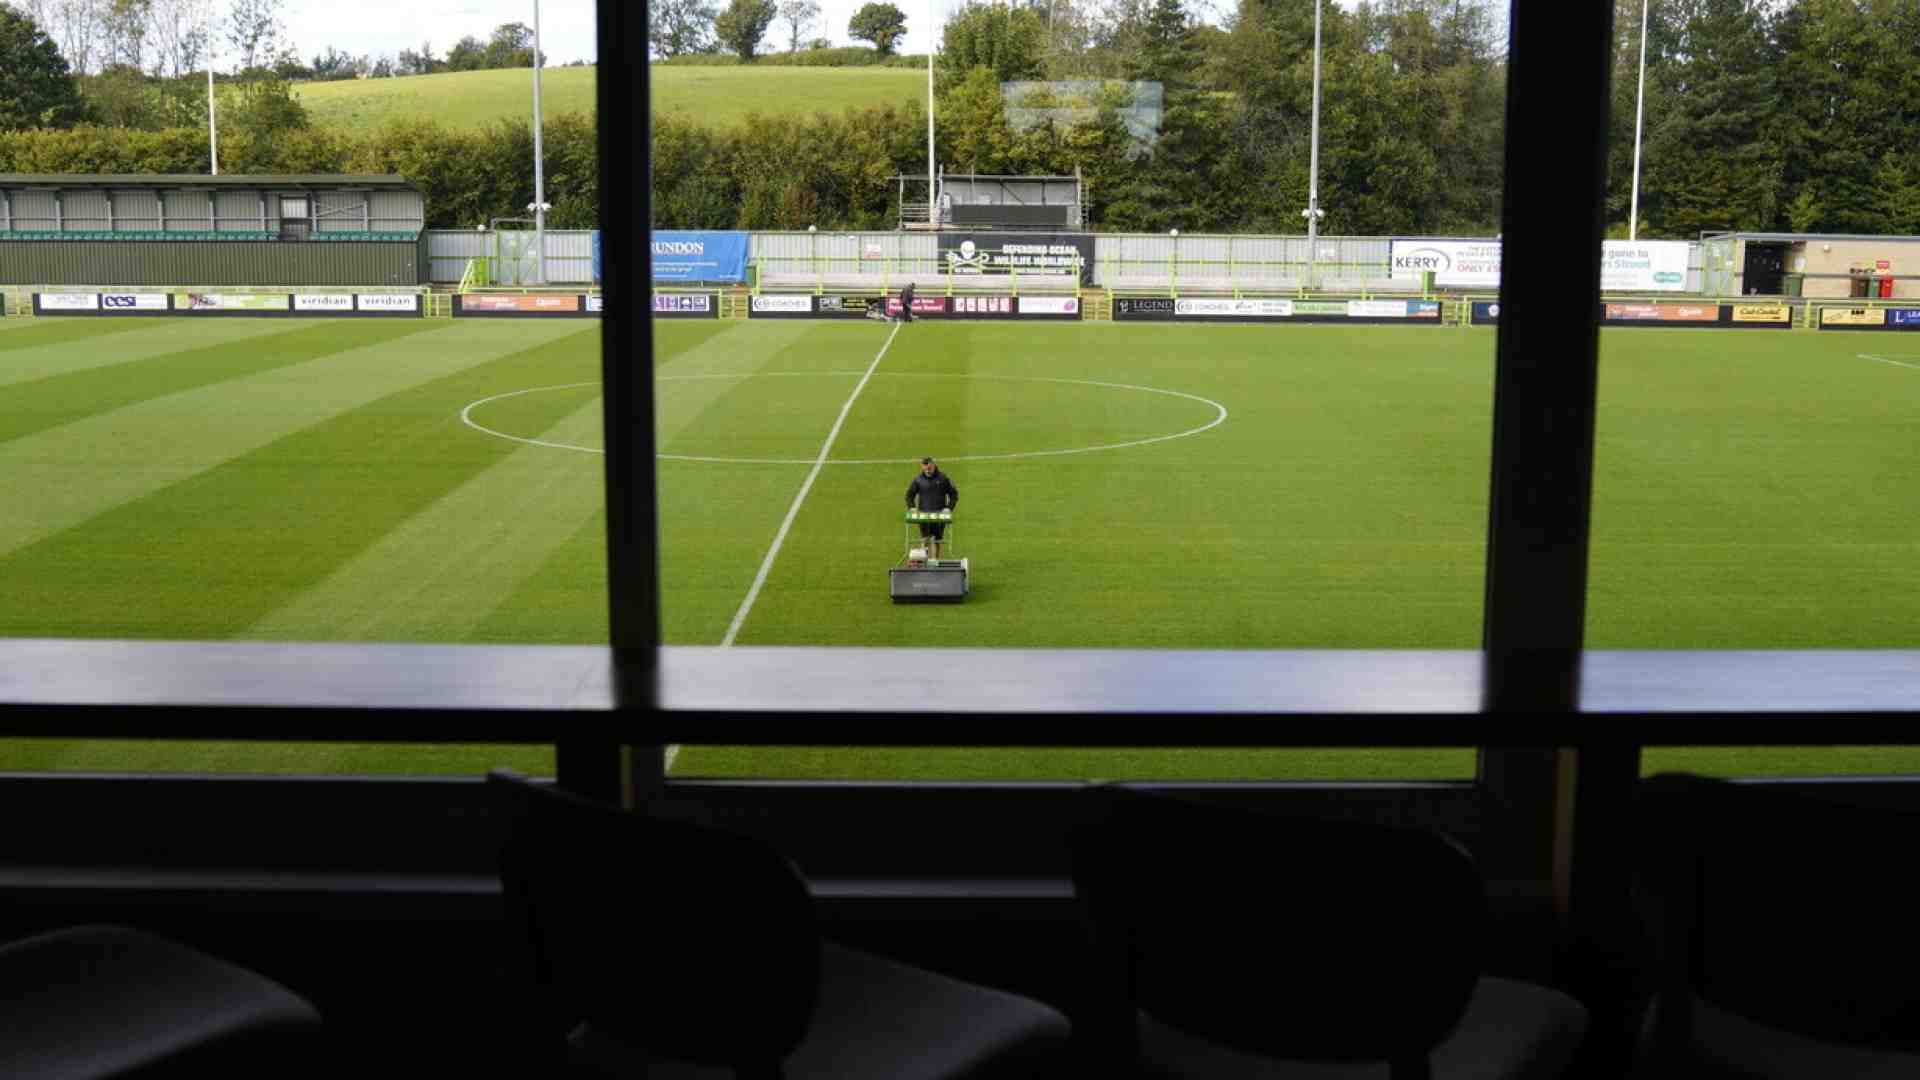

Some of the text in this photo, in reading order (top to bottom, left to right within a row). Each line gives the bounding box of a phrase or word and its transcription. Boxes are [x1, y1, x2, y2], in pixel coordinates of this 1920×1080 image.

[1395, 257, 1440, 268] KERRY
[1456, 264, 1482, 273] ONLY
[301, 296, 347, 305] viridian
[364, 296, 410, 305] viridian
[1133, 301, 1174, 309] LEGEND
